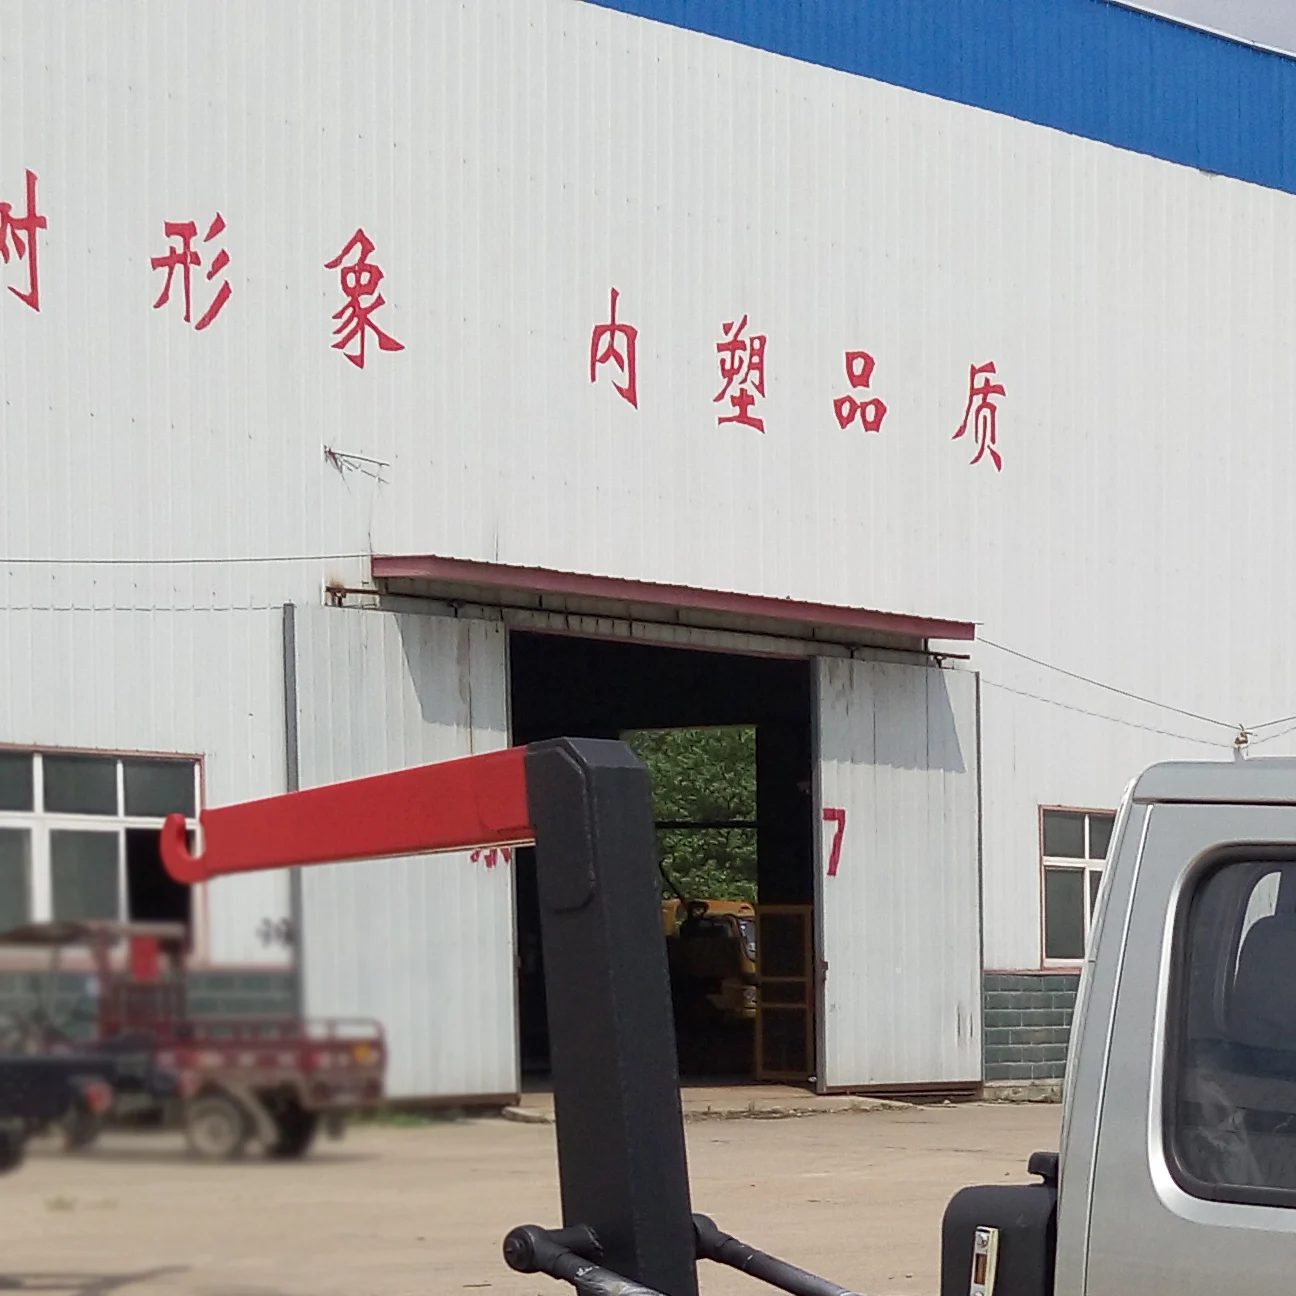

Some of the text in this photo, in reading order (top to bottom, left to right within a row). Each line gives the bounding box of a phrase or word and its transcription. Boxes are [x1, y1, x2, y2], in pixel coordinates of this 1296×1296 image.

[589, 287, 1007, 471] 内塑品质
[823, 808, 846, 877] 7
